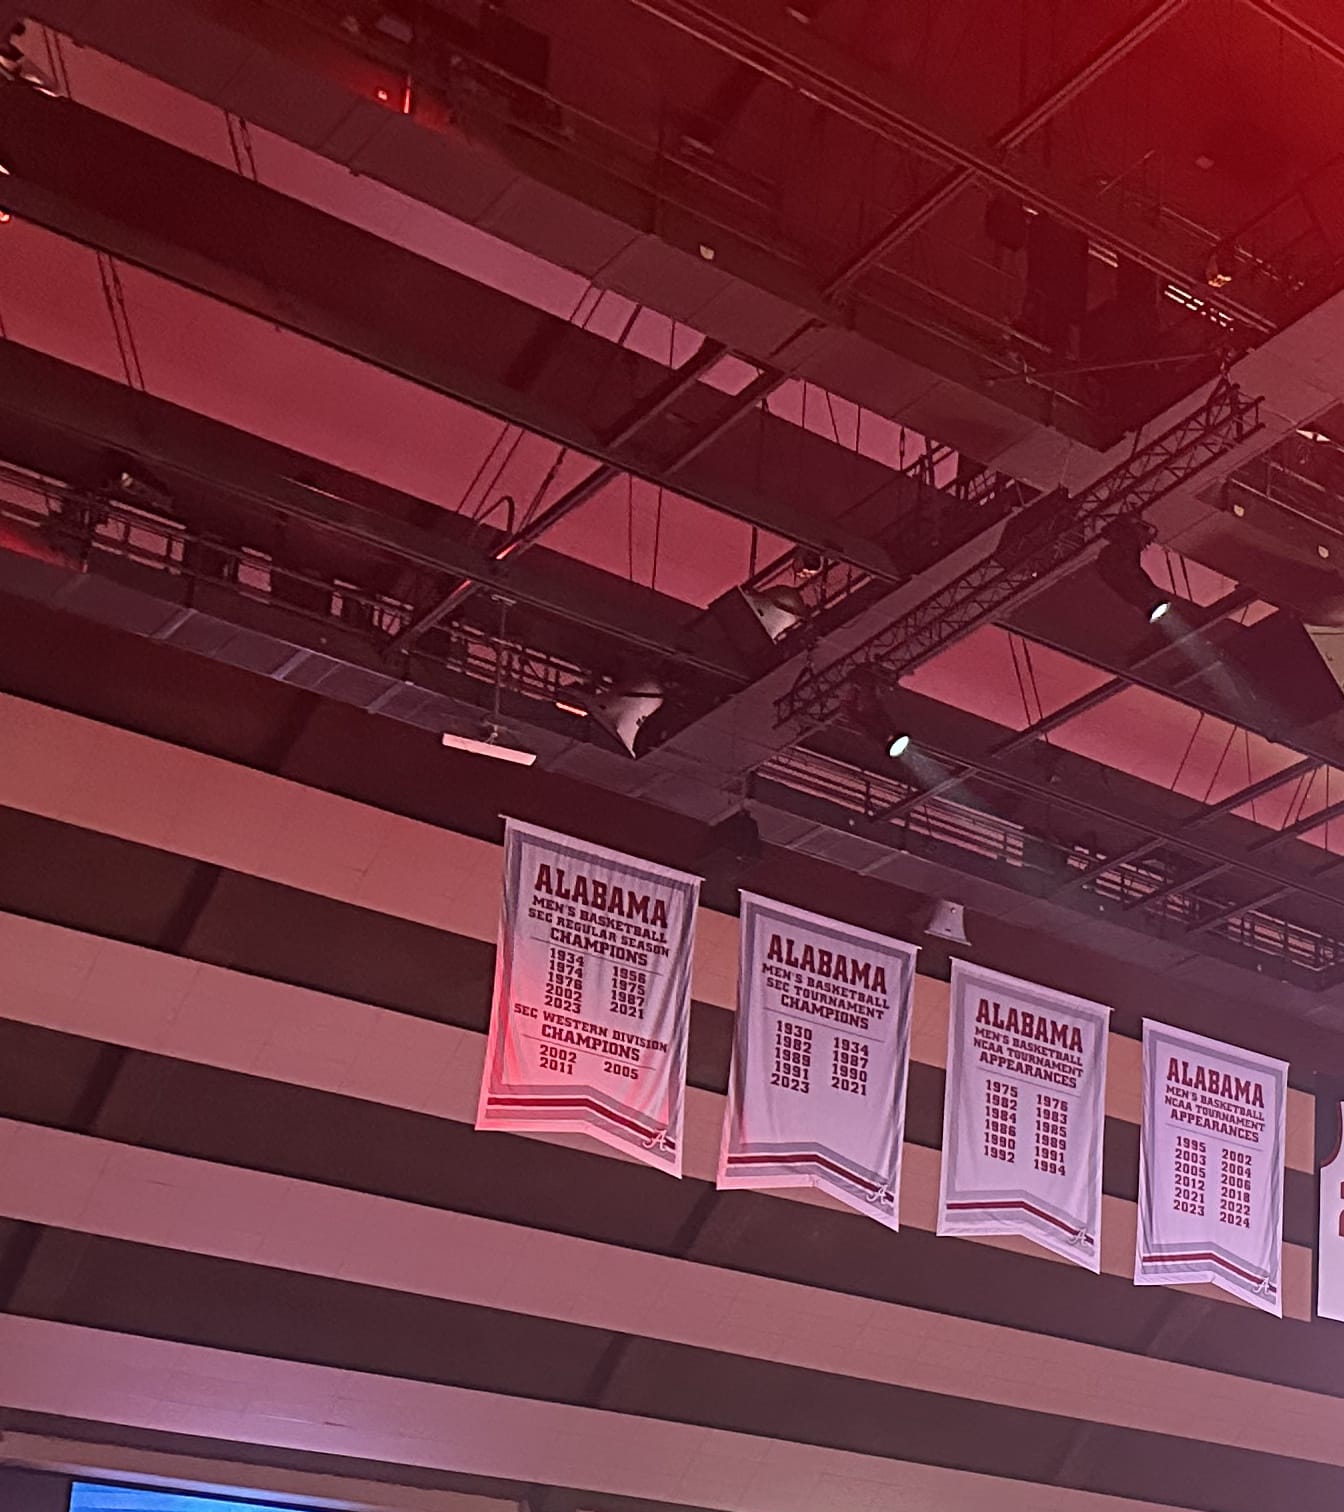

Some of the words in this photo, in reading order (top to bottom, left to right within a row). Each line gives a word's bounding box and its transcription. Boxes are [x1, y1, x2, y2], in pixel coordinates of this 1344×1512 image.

[534, 863, 670, 930] ALABAMA
[528, 907, 553, 924] SEC
[556, 916, 617, 943] REGULAR
[620, 934, 669, 958] SEASON
[532, 894, 576, 918] MEN'S
[579, 909, 667, 944] BASKETBALL
[550, 927, 648, 967] CHAMPIONS
[767, 933, 887, 995] ALABAMA
[761, 962, 803, 984] MEN'S
[806, 976, 890, 1010] BASKETBALL
[766, 976, 790, 993] SEC
[793, 984, 884, 1020] TOURNAMENT
[514, 1002, 538, 1019] SEC
[543, 1010, 608, 1038] WESTERN
[611, 1029, 668, 1054] DIVISION
[780, 993, 869, 1030] CHAMPIONS
[975, 998, 1083, 1054] ALABAMA
[541, 1023, 640, 1062] CHAMPIONS
[973, 1037, 1004, 1055] NCAA
[1006, 1047, 1083, 1078] TOURNAMENT
[975, 1026, 1010, 1045] MEN'S
[1012, 1037, 1083, 1067] BASKETBALL
[979, 1050, 1077, 1089] APPEARANCES
[1166, 1057, 1264, 1109] ALABAMA
[986, 1079, 1018, 1098] 1975
[1037, 1093, 1068, 1112] 1976
[986, 1092, 1017, 1111] 1982
[1036, 1106, 1068, 1125] 1983
[1164, 1095, 1193, 1112] NCAA
[1195, 1104, 1265, 1132] TOURNAMENT
[1166, 1084, 1198, 1102] MEN'S
[1200, 1094, 1265, 1122] BASKETBALL
[985, 1105, 1017, 1124] 1984
[1036, 1119, 1067, 1138] 1985
[985, 1118, 1016, 1137] 1986
[1035, 1132, 1066, 1151] 1989
[1170, 1108, 1259, 1143] APPEARANCES
[984, 1144, 1015, 1164] 1992
[1034, 1158, 1066, 1176] 1994
[985, 1131, 1016, 1150] 1990
[1035, 1145, 1064, 1163] 1991
[1175, 1147, 1206, 1166] 2003
[1221, 1160, 1251, 1179] 2004
[1176, 1135, 1206, 1153] 1995
[1221, 1148, 1252, 1166] 2002
[1174, 1160, 1206, 1179] 2005
[1221, 1173, 1251, 1191] 2006
[1174, 1173, 1205, 1191] 2012
[1221, 1186, 1250, 1203] 2018
[1173, 1199, 1205, 1217] 2023
[1219, 1211, 1250, 1229] 2024
[1174, 1186, 1204, 1204] 2021
[1220, 1198, 1250, 1216] 2022
